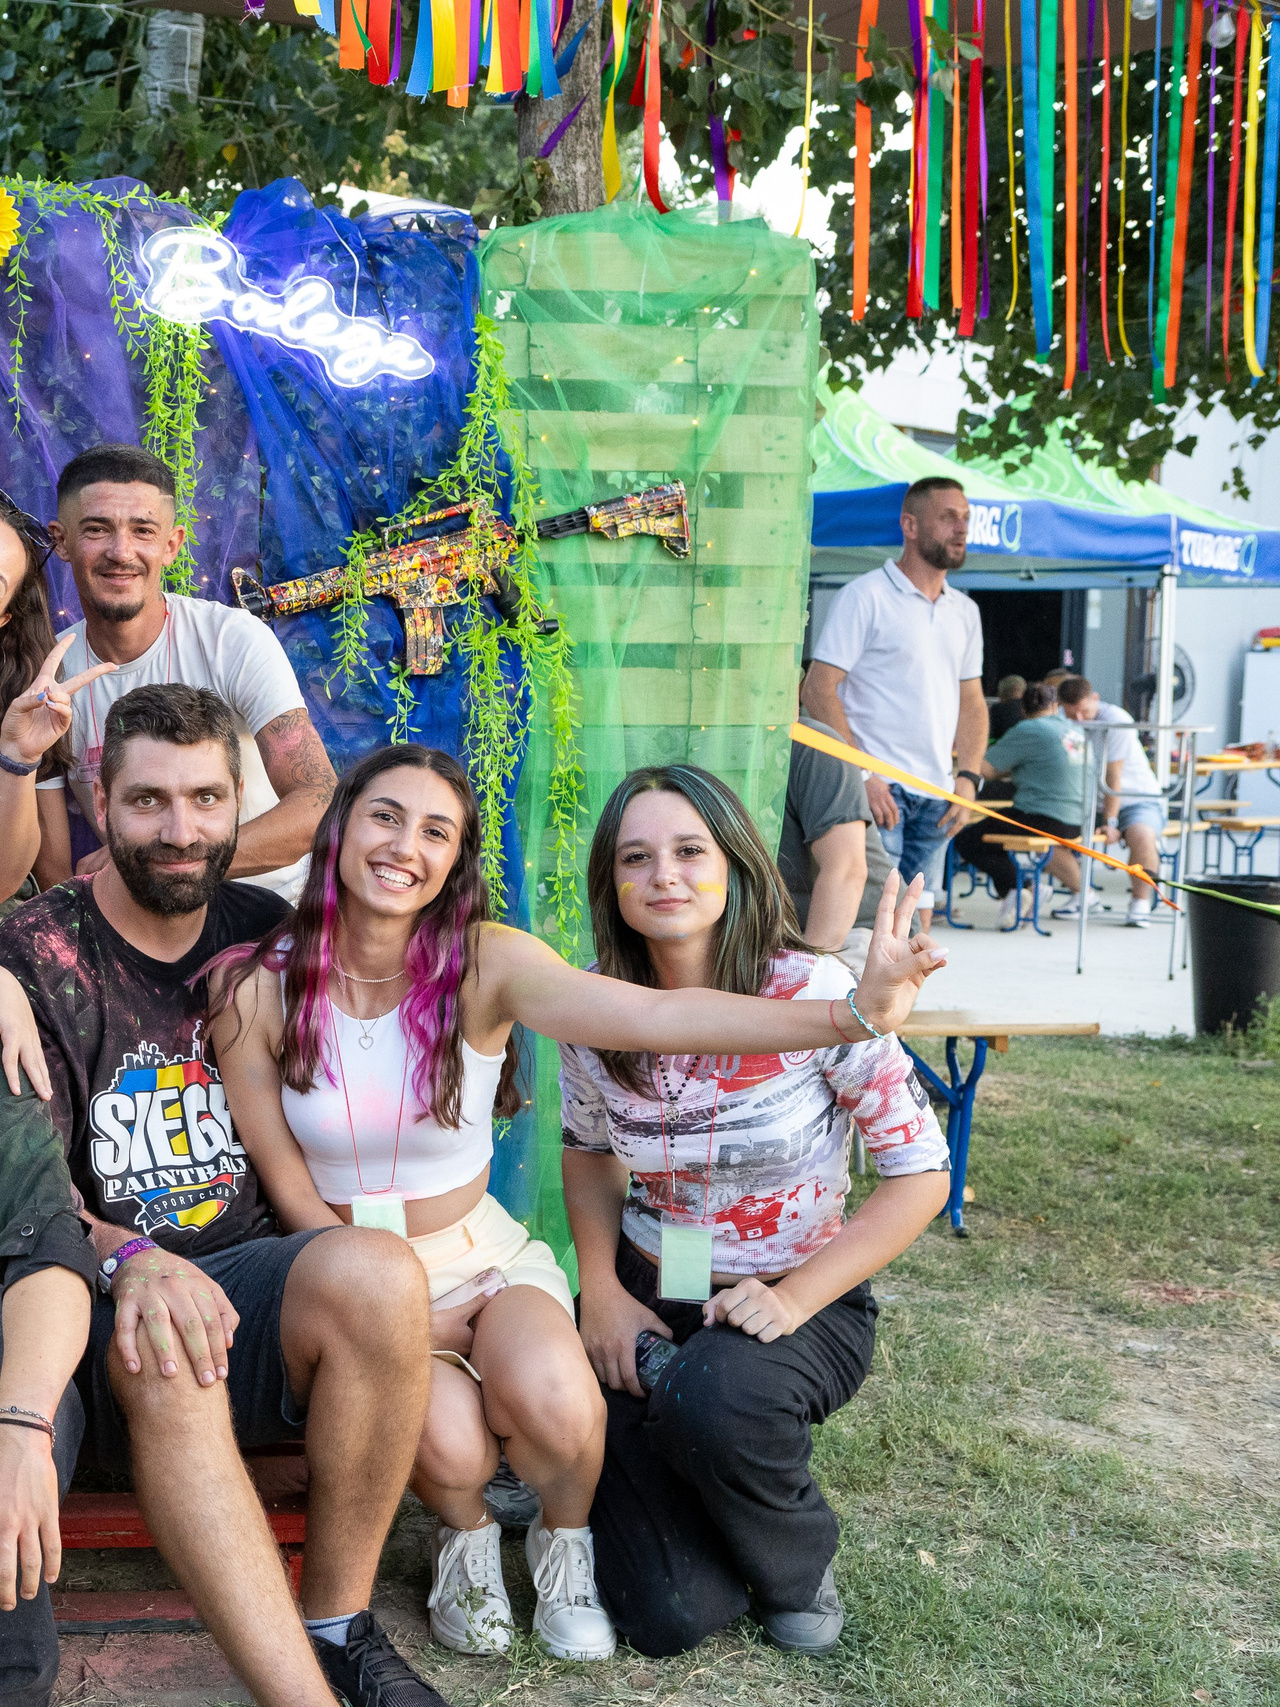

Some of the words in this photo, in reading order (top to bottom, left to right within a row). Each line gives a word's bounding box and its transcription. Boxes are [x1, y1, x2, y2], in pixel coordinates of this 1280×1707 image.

[1180, 529, 1243, 572] TUBORG
[153, 1194, 194, 1213] SPORT
[199, 1186, 230, 1200] CLUB
